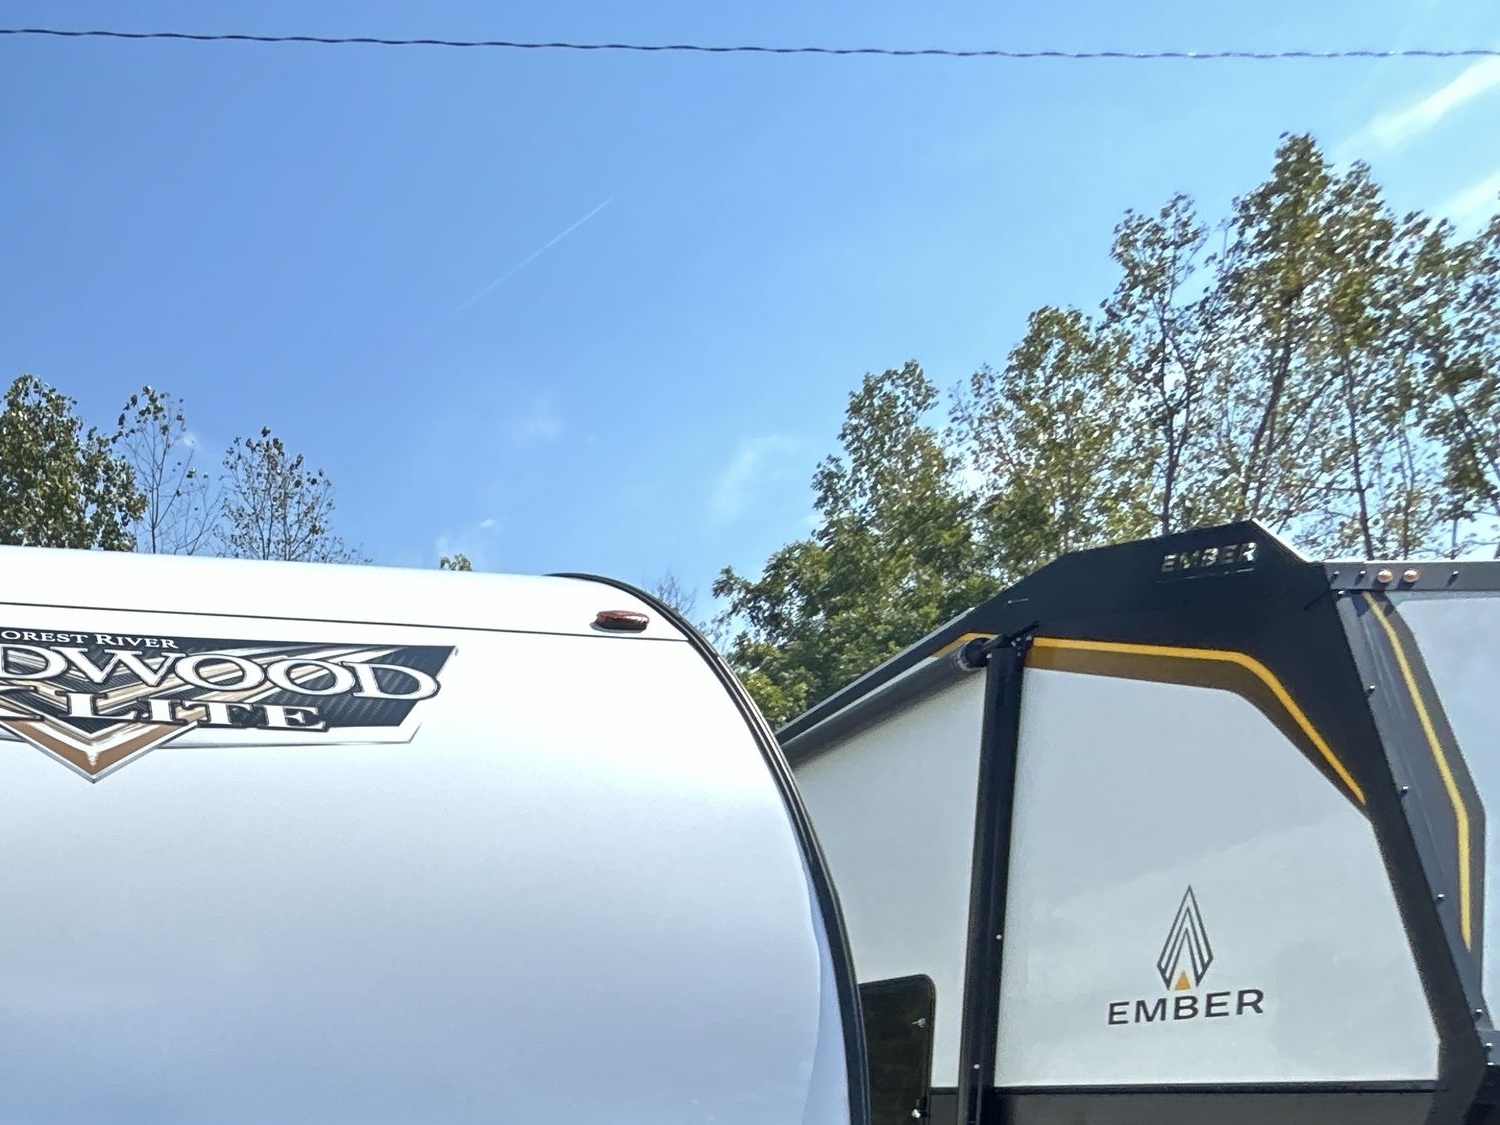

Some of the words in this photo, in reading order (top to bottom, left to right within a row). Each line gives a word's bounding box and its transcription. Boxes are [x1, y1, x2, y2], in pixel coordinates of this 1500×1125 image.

[1161, 542, 1257, 573] EMBER
[95, 634, 179, 649] RIVER
[54, 688, 329, 732] LITE
[1107, 988, 1265, 1026] EMBER
